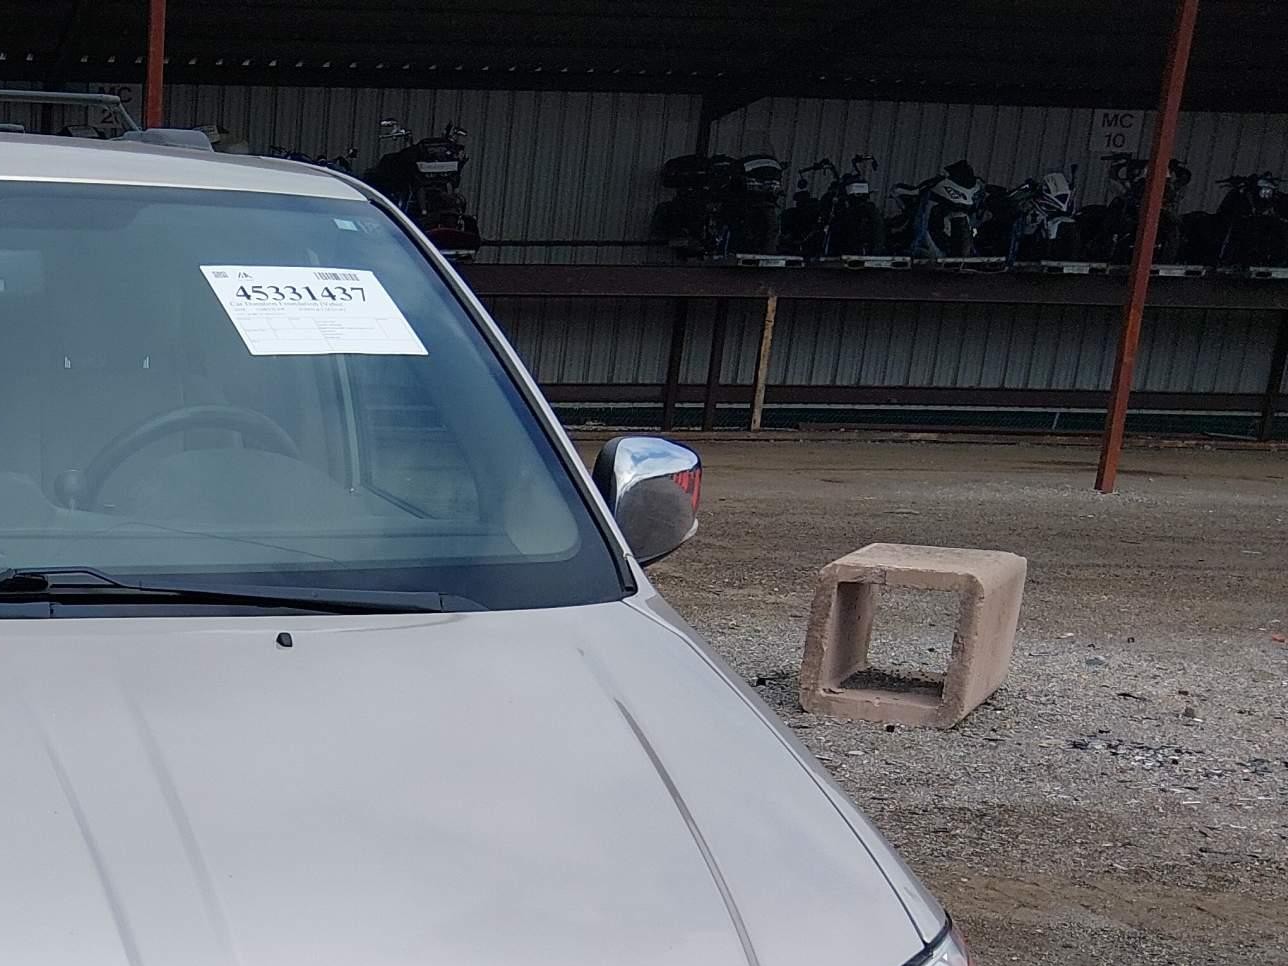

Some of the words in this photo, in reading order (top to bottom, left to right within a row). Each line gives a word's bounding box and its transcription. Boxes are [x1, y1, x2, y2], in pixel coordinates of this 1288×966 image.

[1101, 112, 1134, 129] MC
[1104, 133, 1126, 148] 10
[235, 285, 367, 302] 45331437
